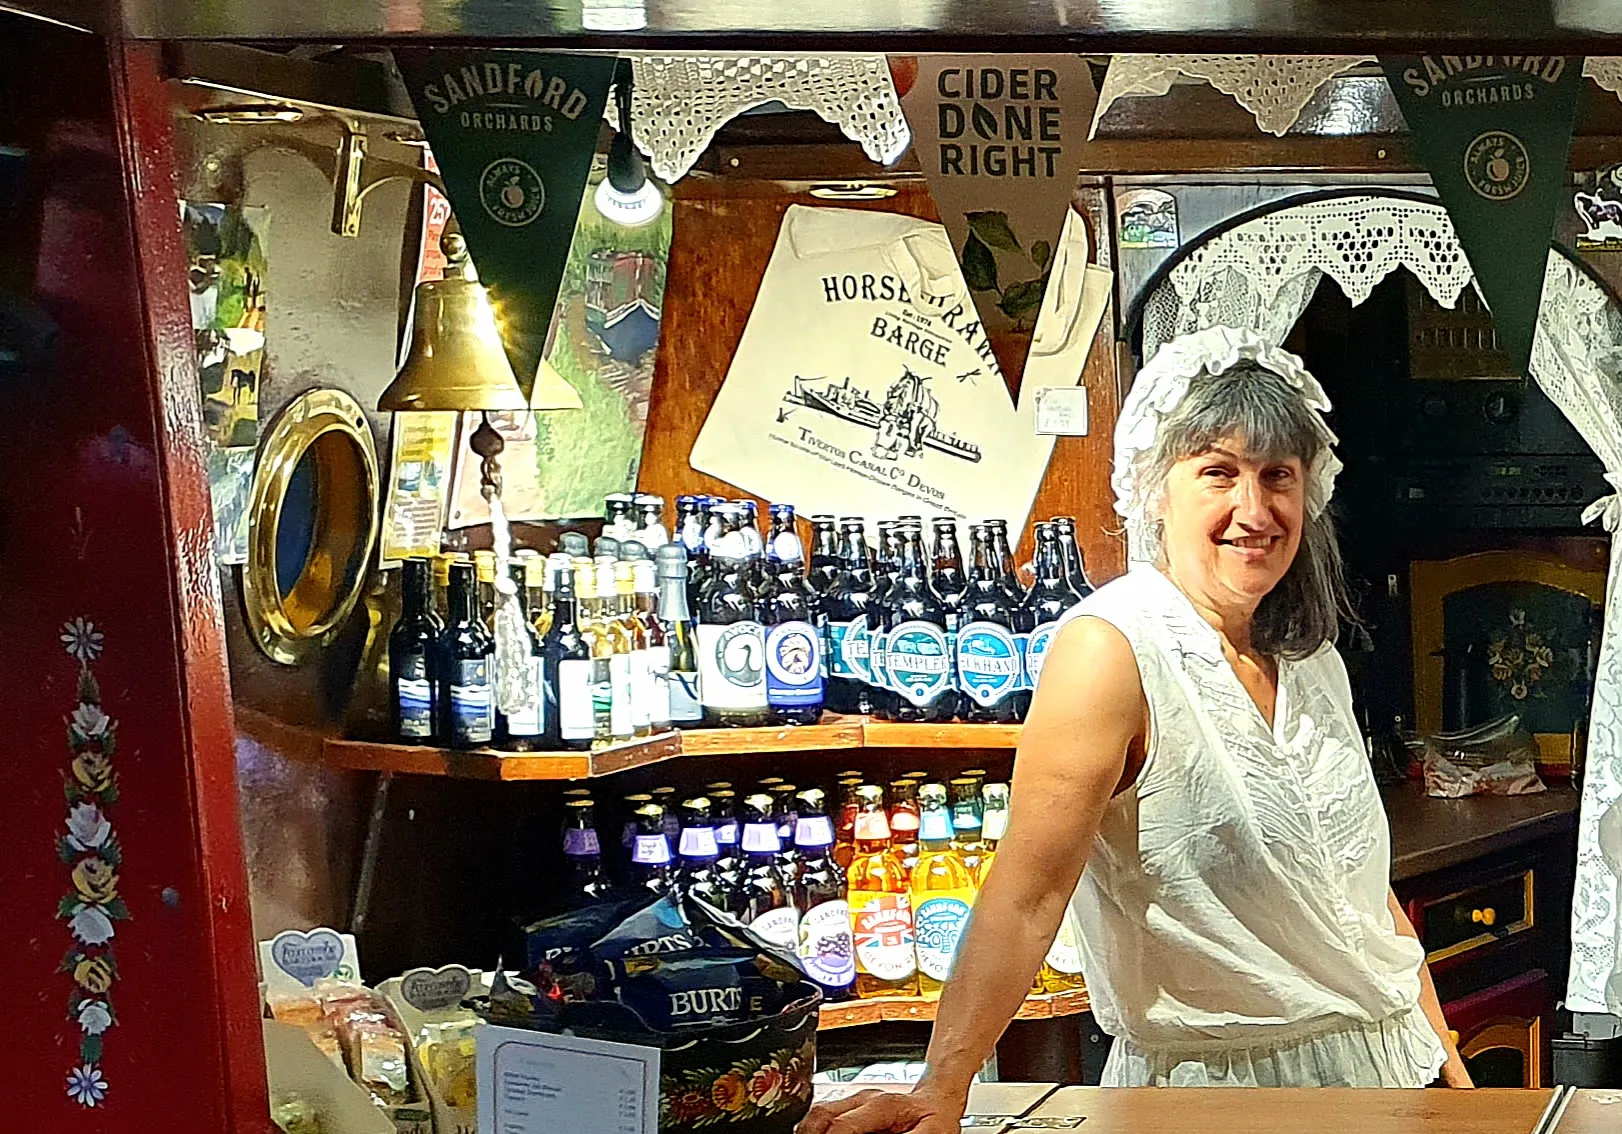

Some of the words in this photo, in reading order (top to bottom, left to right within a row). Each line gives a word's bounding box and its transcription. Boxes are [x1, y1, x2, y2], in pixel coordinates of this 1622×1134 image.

[424, 62, 587, 120] SANDFORD
[938, 68, 1059, 100] CIDER
[1441, 83, 1534, 107] ORCHARDS
[461, 112, 553, 132] ORCHARDS
[938, 102, 1061, 141] DONE
[940, 144, 1061, 177] RIGHT
[871, 317, 951, 367] BARGE
[907, 473, 945, 500] DEVON
